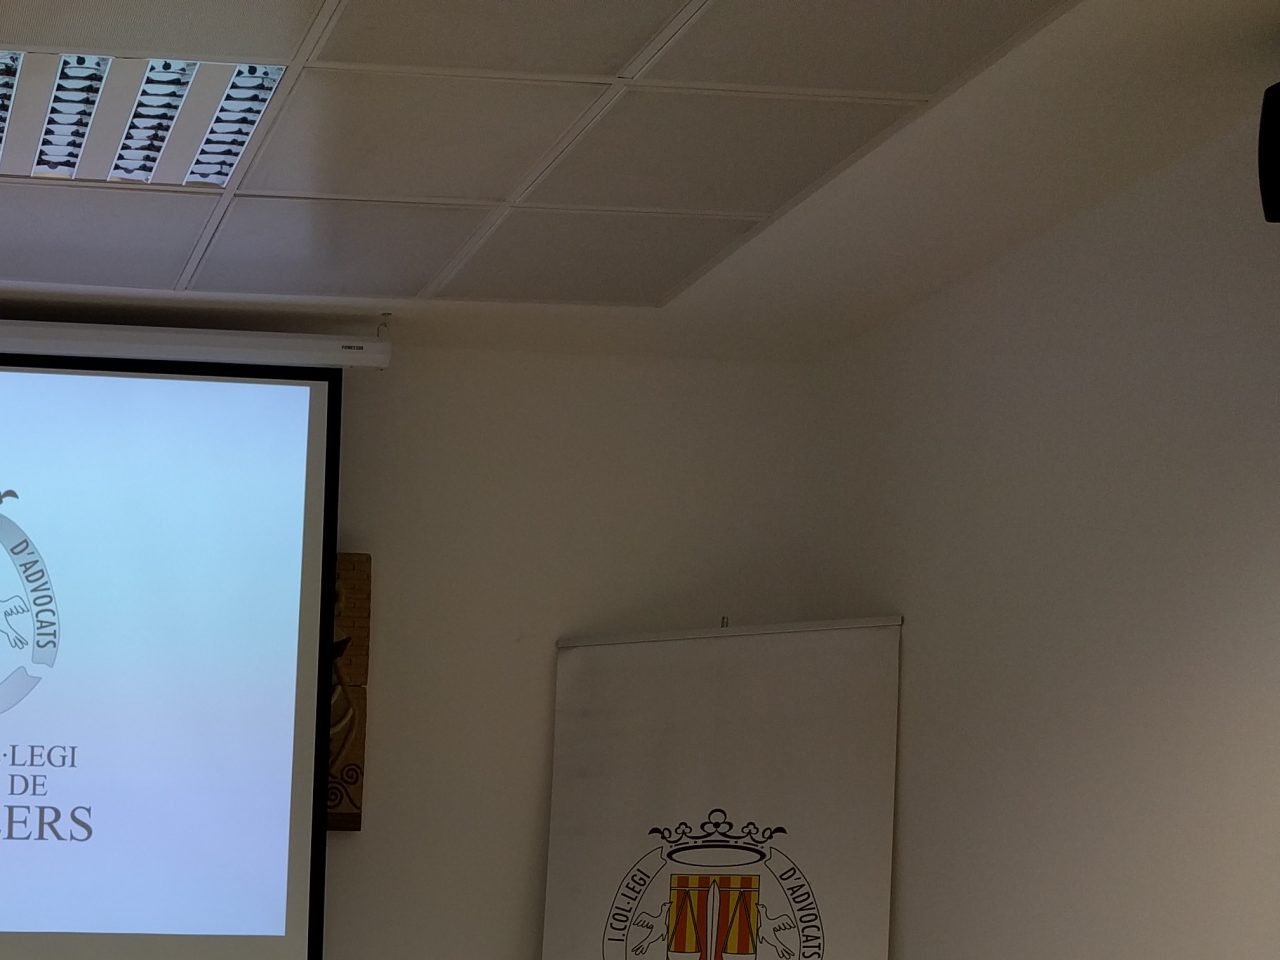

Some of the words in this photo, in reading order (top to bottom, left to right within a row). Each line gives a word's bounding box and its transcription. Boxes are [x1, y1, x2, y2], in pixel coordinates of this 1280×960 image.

[10, 538, 57, 649] D'ADVOCATS
[8, 774, 48, 796] DE
[779, 867, 822, 959] D'ADVOCATS
